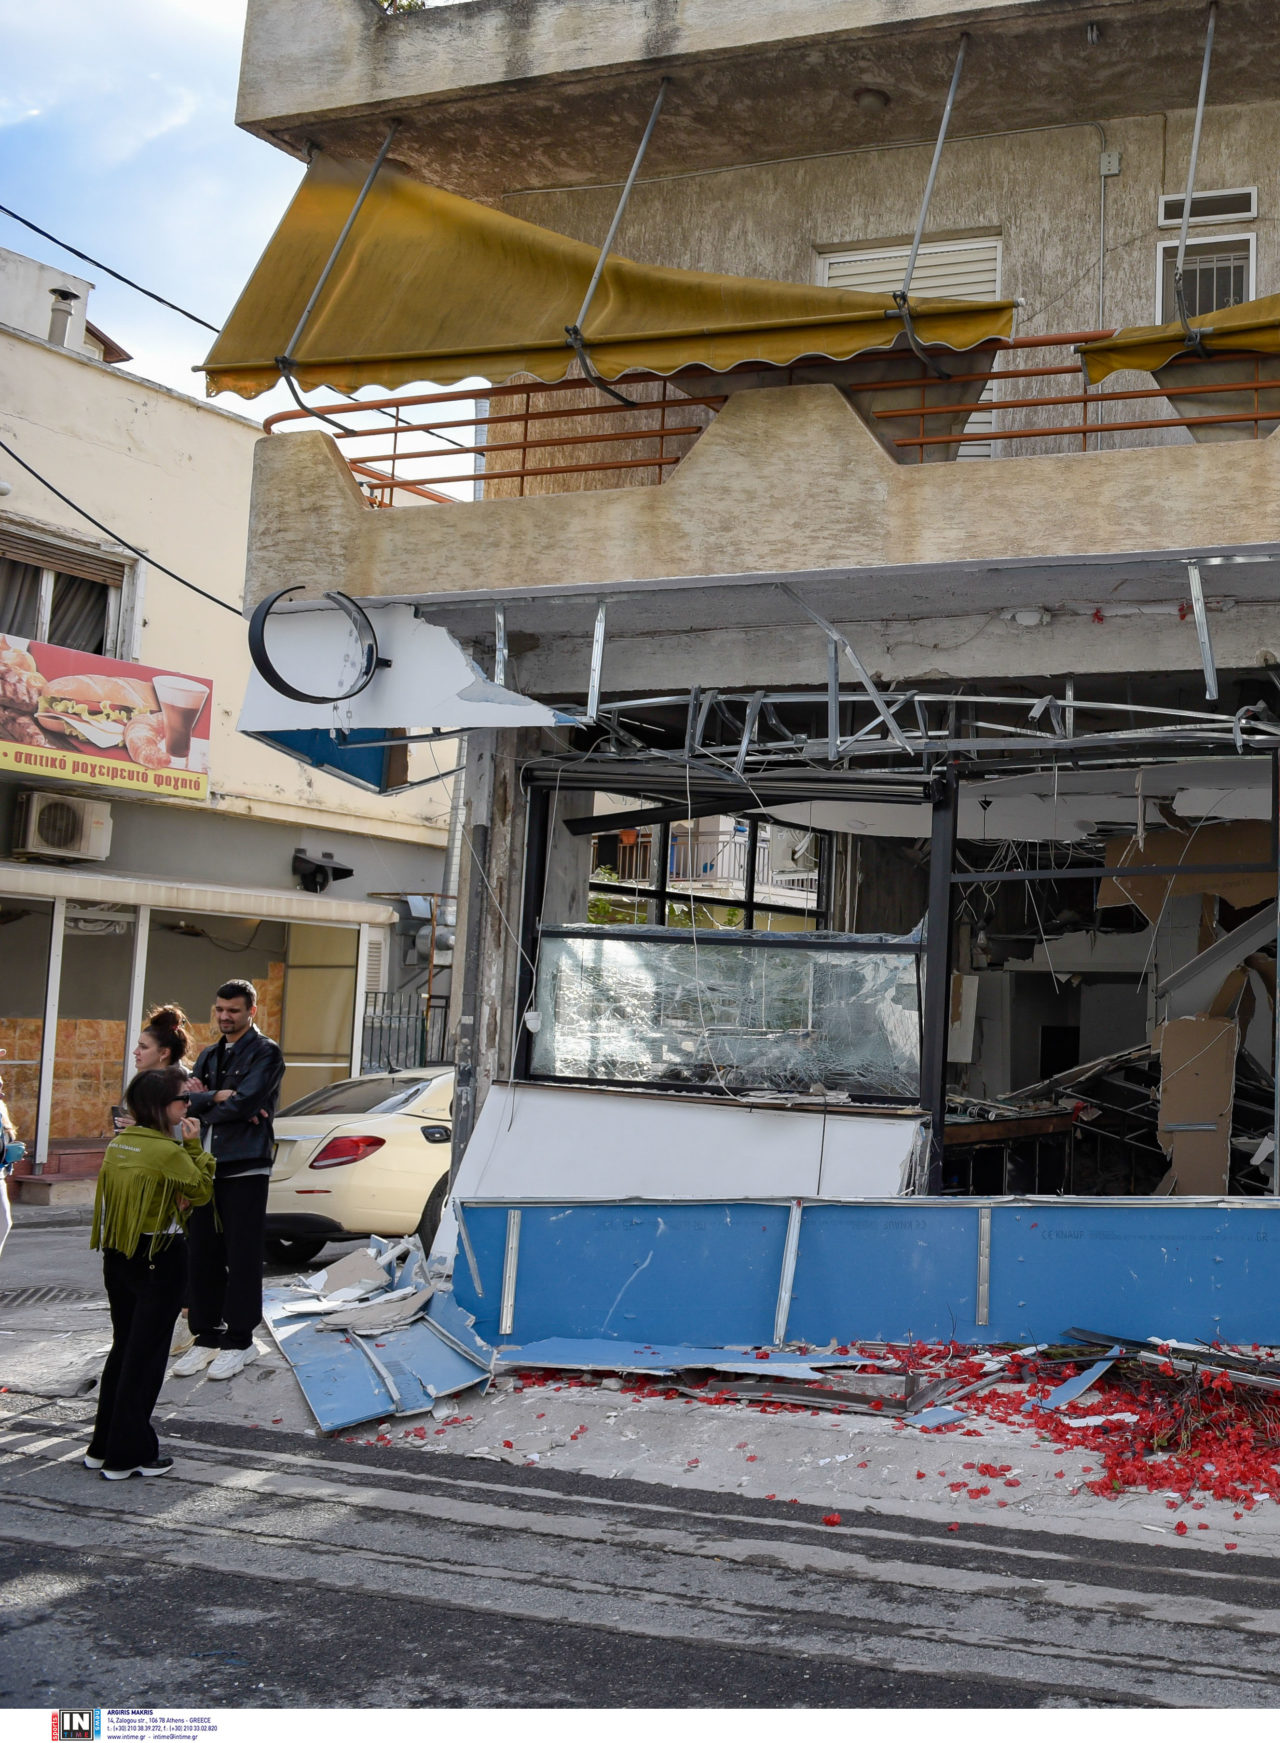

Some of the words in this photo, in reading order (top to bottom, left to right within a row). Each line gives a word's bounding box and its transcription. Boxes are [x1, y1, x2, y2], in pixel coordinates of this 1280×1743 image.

[14, 751, 67, 770] σπιτικό
[72, 760, 148, 783] μαγειρευτό
[153, 773, 201, 791] φαγητό
[1055, 1230, 1084, 1240] KNAUF
